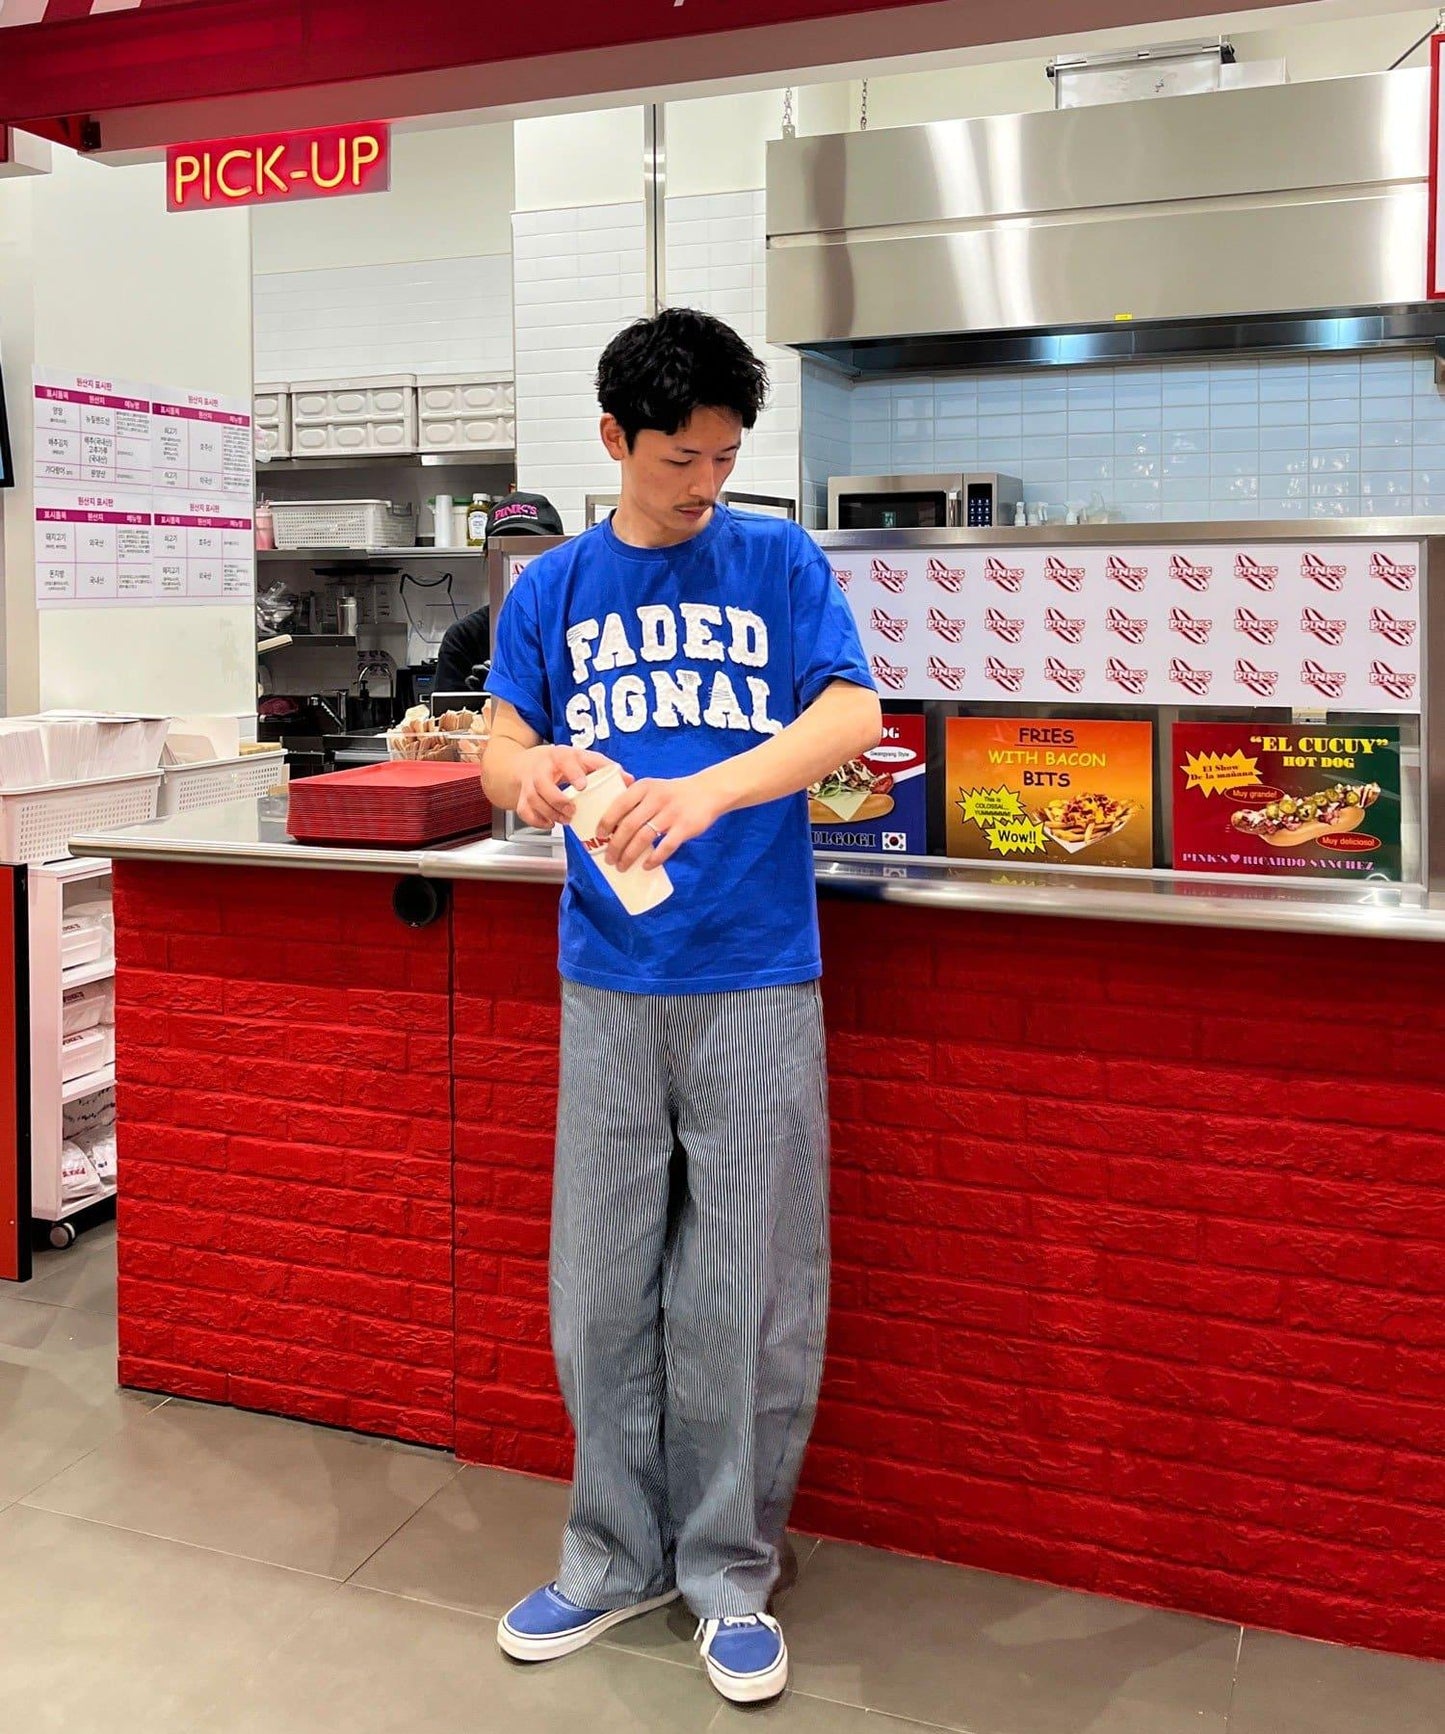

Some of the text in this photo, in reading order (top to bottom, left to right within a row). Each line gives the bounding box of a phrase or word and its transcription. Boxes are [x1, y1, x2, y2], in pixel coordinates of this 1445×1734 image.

[173, 134, 380, 205] PICK-UP
[76, 377, 112, 391] 원산지 표시판
[88, 395, 106, 406] 원산지
[188, 395, 219, 408] 원산지 표시판
[77, 496, 114, 508] 원산지 표시판
[189, 503, 220, 514] 원산지 표시판
[87, 513, 104, 522] 원산지
[494, 502, 539, 521] PINK'S
[45, 532, 67, 542] 돼지고기
[566, 602, 769, 684] FADED
[565, 669, 784, 750] SIGNAL
[1018, 727, 1075, 744] FRIES
[988, 750, 1107, 767] WITH BACON
[1283, 756, 1355, 768] HOT DOG
[1023, 770, 1071, 788] BITS
[1217, 770, 1254, 779] mañana
[1232, 789, 1277, 800] Muy grande!
[811, 830, 876, 847] ULGOGI
[998, 829, 1037, 844] Wow!!
[1322, 836, 1376, 848] Muy delicioso!
[1242, 856, 1306, 867] RICARDO
[1309, 859, 1375, 871] SANCHEZ
